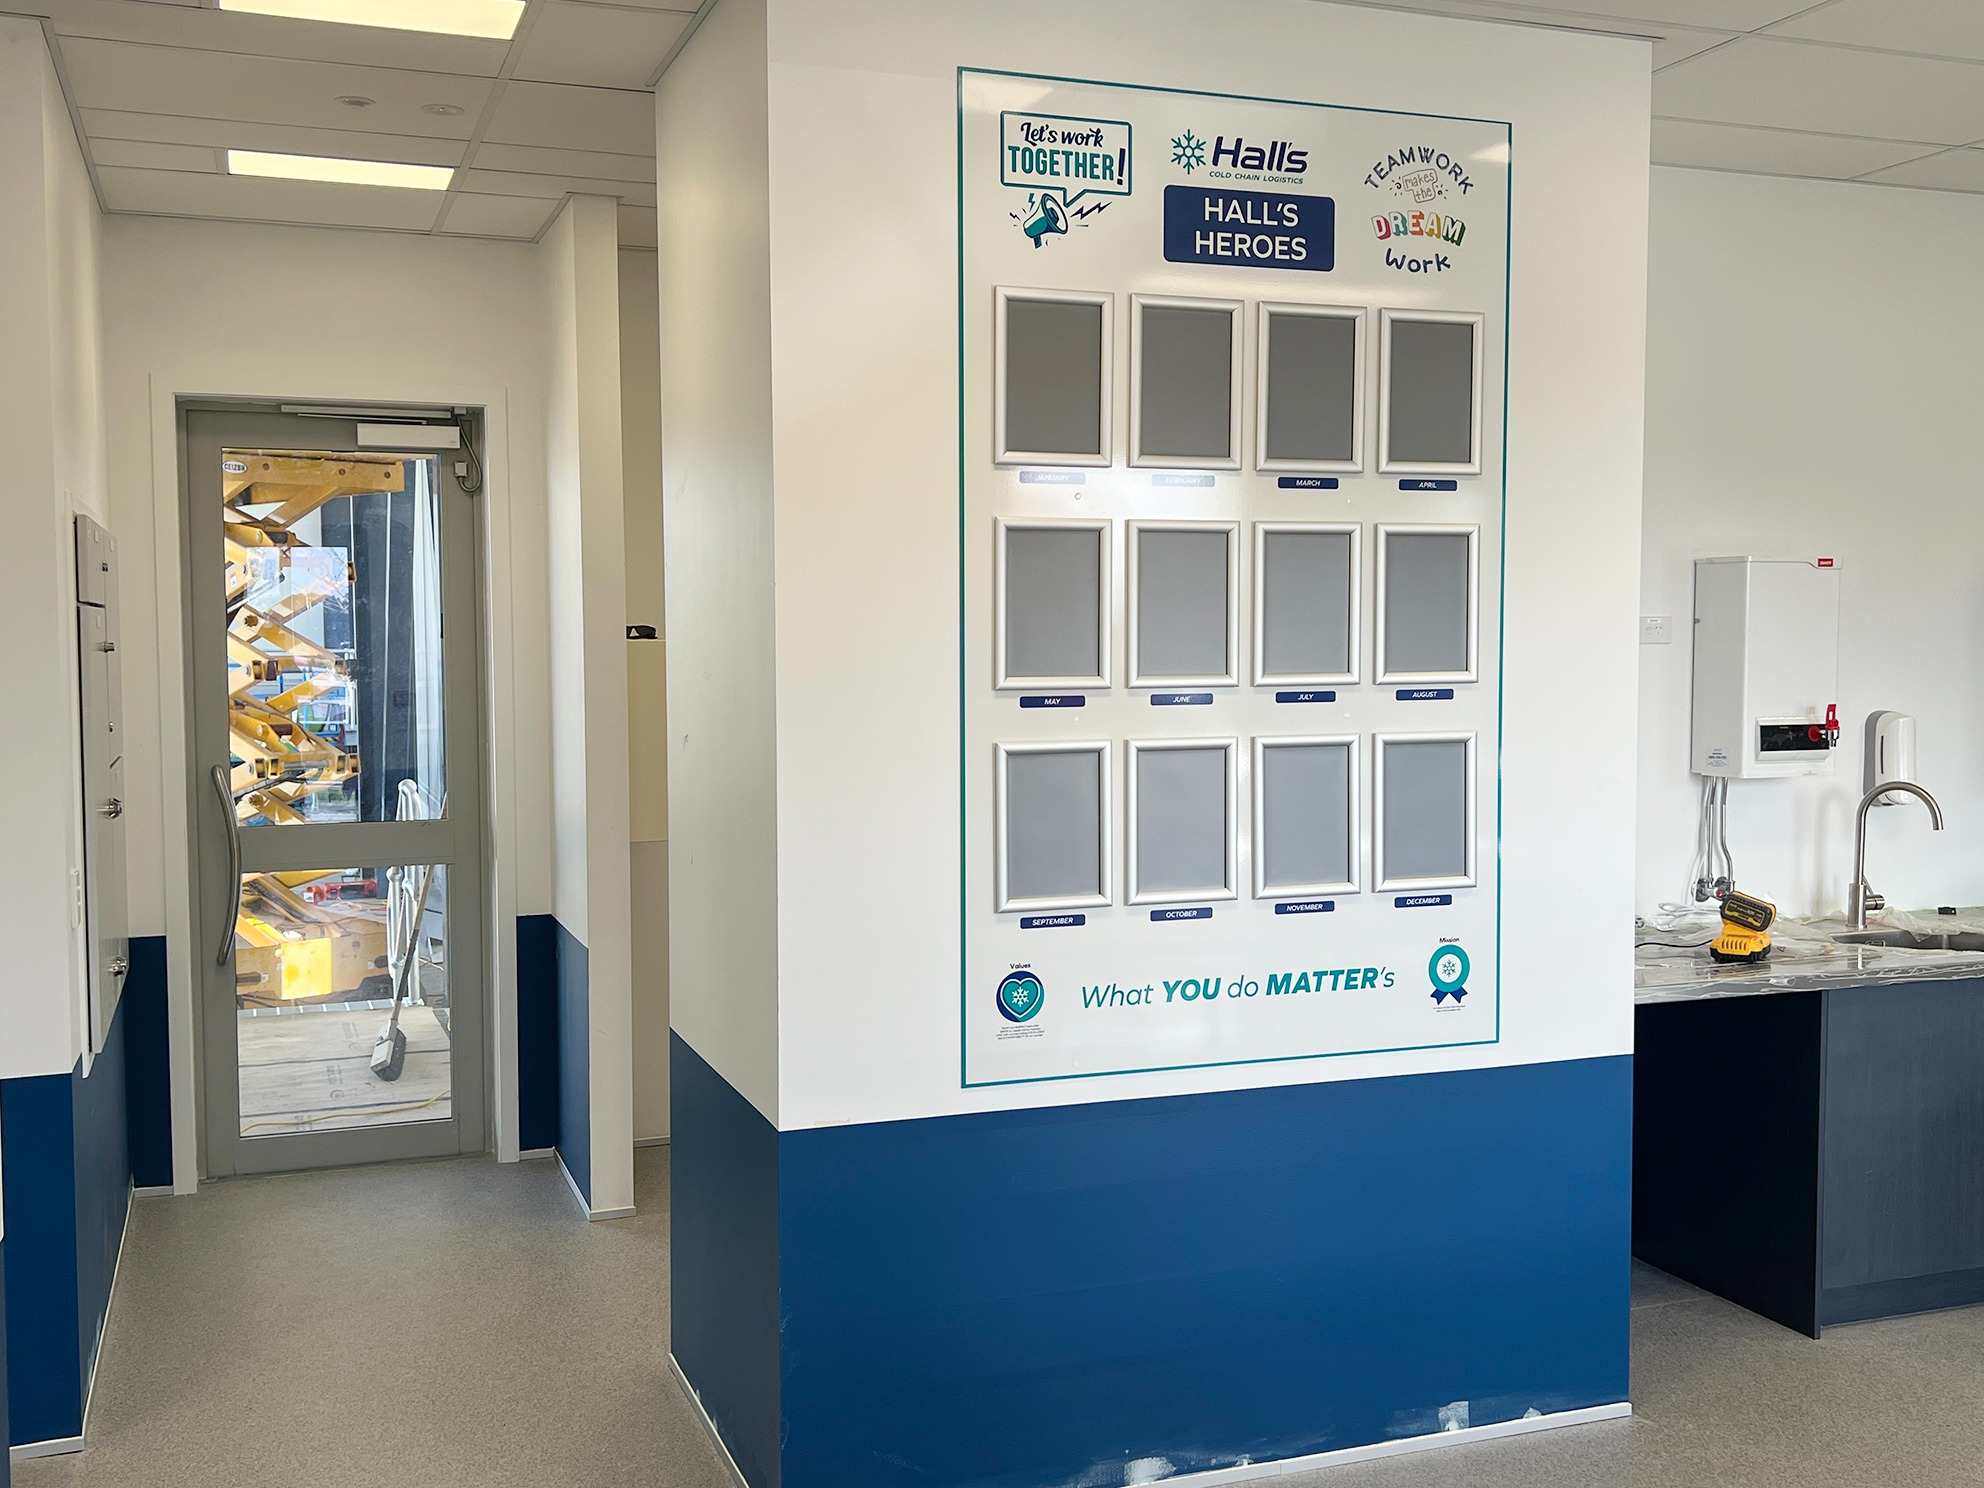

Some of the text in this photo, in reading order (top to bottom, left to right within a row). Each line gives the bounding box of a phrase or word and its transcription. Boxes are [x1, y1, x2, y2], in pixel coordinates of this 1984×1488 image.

[1020, 122, 1104, 148] Let's work
[1212, 136, 1309, 173] Hall's
[1008, 145, 1126, 186] TOGETHER!
[1364, 146, 1474, 195] TEAMWORK
[1209, 170, 1304, 184] COLD CHAIN LOGISTICS
[1404, 171, 1435, 189] makes
[1415, 187, 1433, 200] the
[1204, 197, 1299, 227] HALL'S
[1371, 210, 1466, 246] DREAM
[1195, 230, 1307, 261] HEROES
[1295, 479, 1321, 487] MARCH
[1172, 695, 1191, 703] JUNE
[1297, 693, 1314, 701] JULY
[1286, 903, 1323, 912] NOVEMBER
[1406, 897, 1441, 905] DECEMBER
[1032, 917, 1073, 926] SEPTEMBER
[1165, 910, 1198, 918] OCTOBER
[1081, 966, 1395, 1009] What YOU do MATTER's
